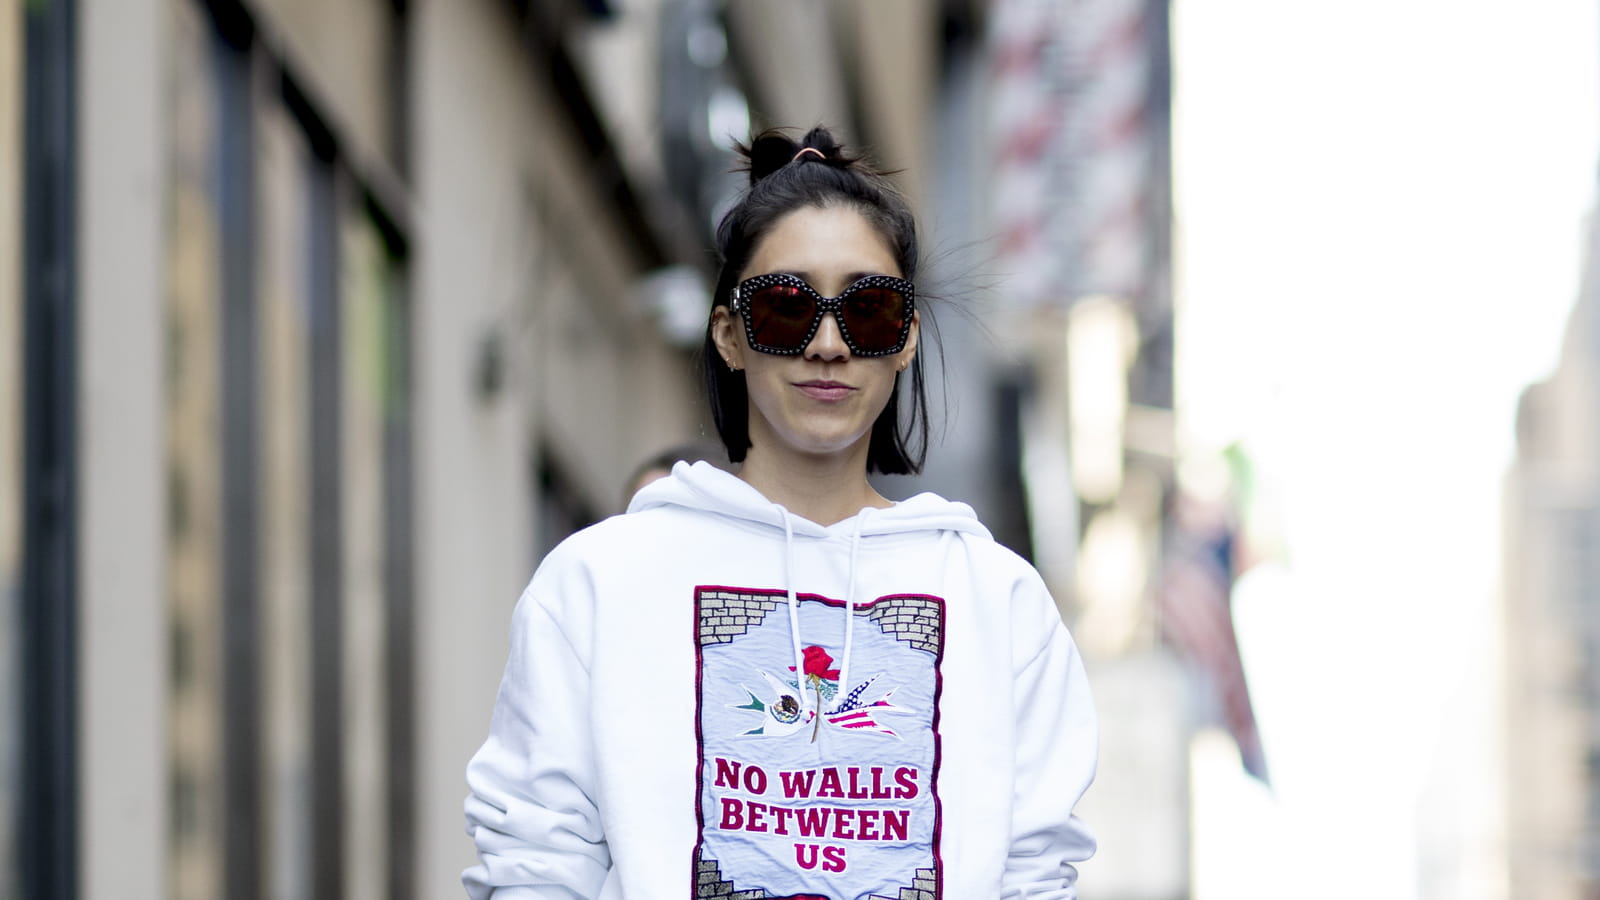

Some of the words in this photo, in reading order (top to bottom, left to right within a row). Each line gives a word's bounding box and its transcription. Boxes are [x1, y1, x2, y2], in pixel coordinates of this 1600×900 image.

[714, 757, 768, 795] NO
[779, 766, 919, 799] WALLS
[719, 797, 910, 841] BETWEEN
[793, 843, 847, 873] US
